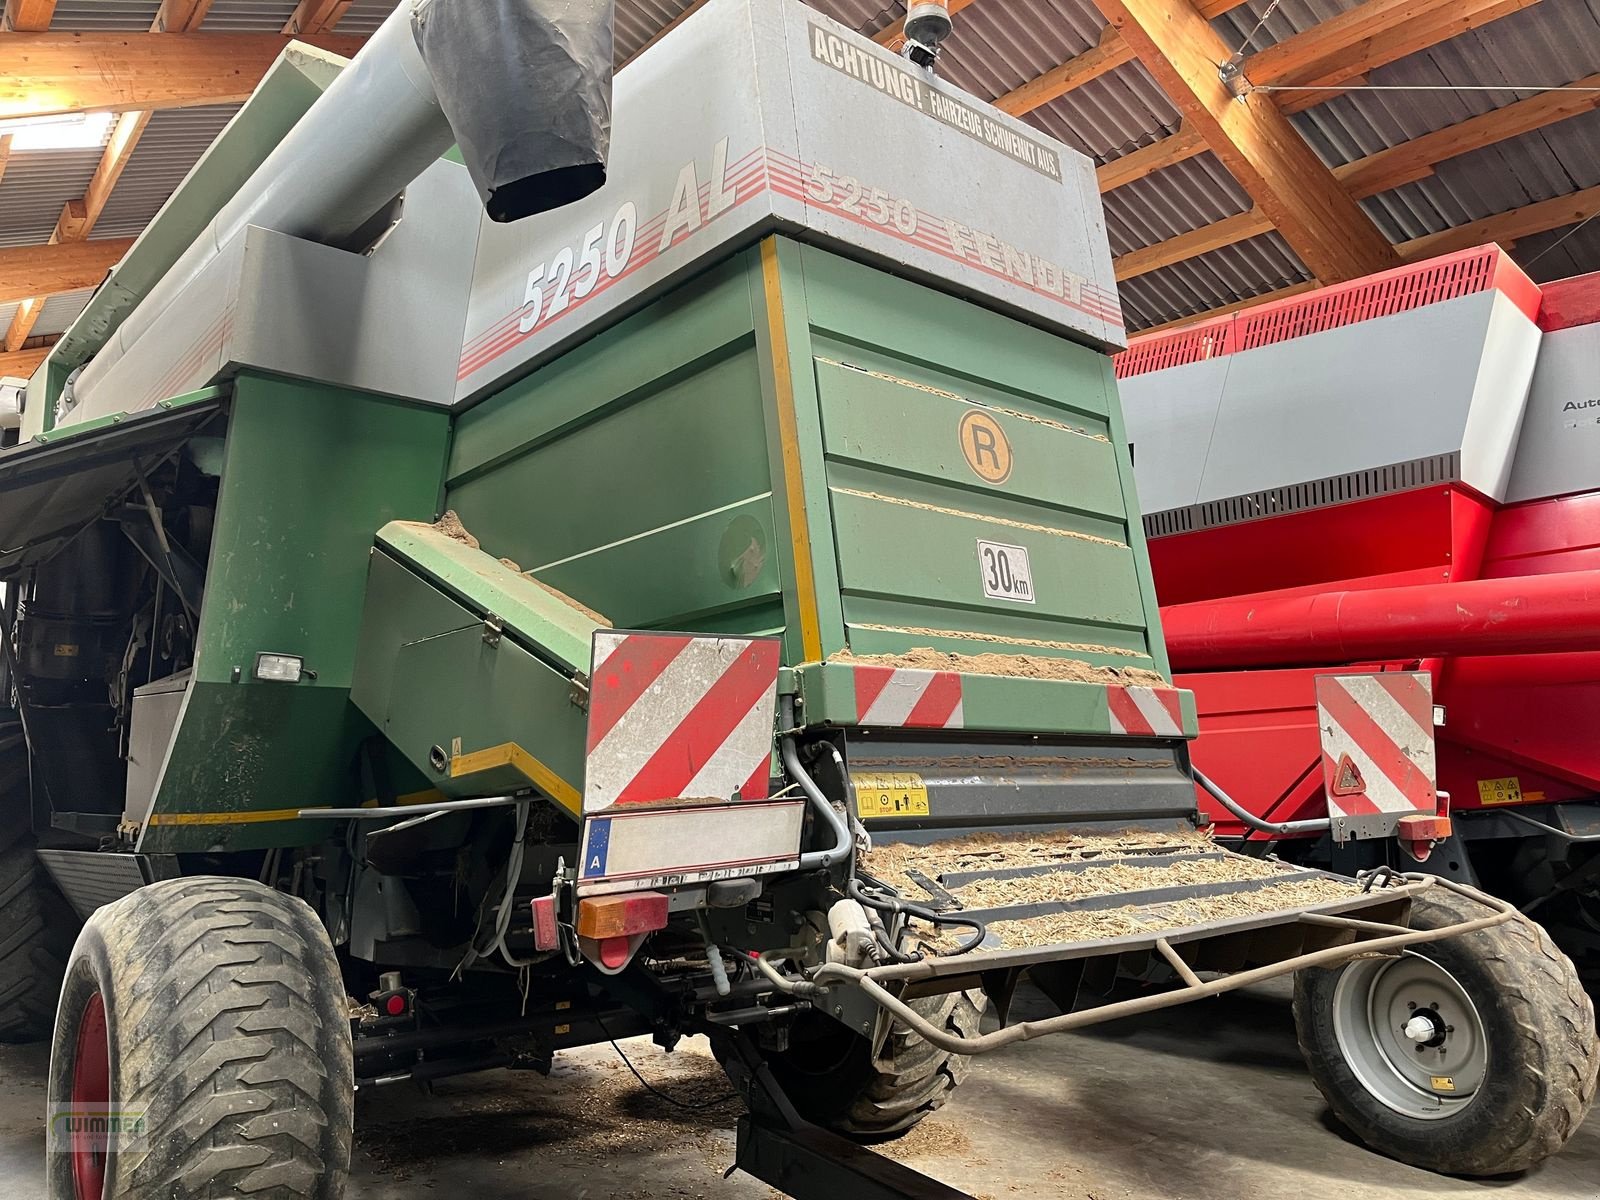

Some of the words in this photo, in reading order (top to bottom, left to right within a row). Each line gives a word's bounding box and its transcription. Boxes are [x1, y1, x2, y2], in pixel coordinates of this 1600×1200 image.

[814, 27, 923, 109] ACHTUNG!
[929, 91, 983, 138] FAHRZEUG
[983, 119, 1036, 166] SCHWENKT
[1037, 149, 1059, 177] AUS.
[518, 201, 637, 334] 5250
[658, 136, 737, 254] AL
[806, 162, 918, 237] 5250
[943, 216, 1089, 305] FENDT
[971, 423, 1001, 470] R
[590, 855, 601, 869] A
